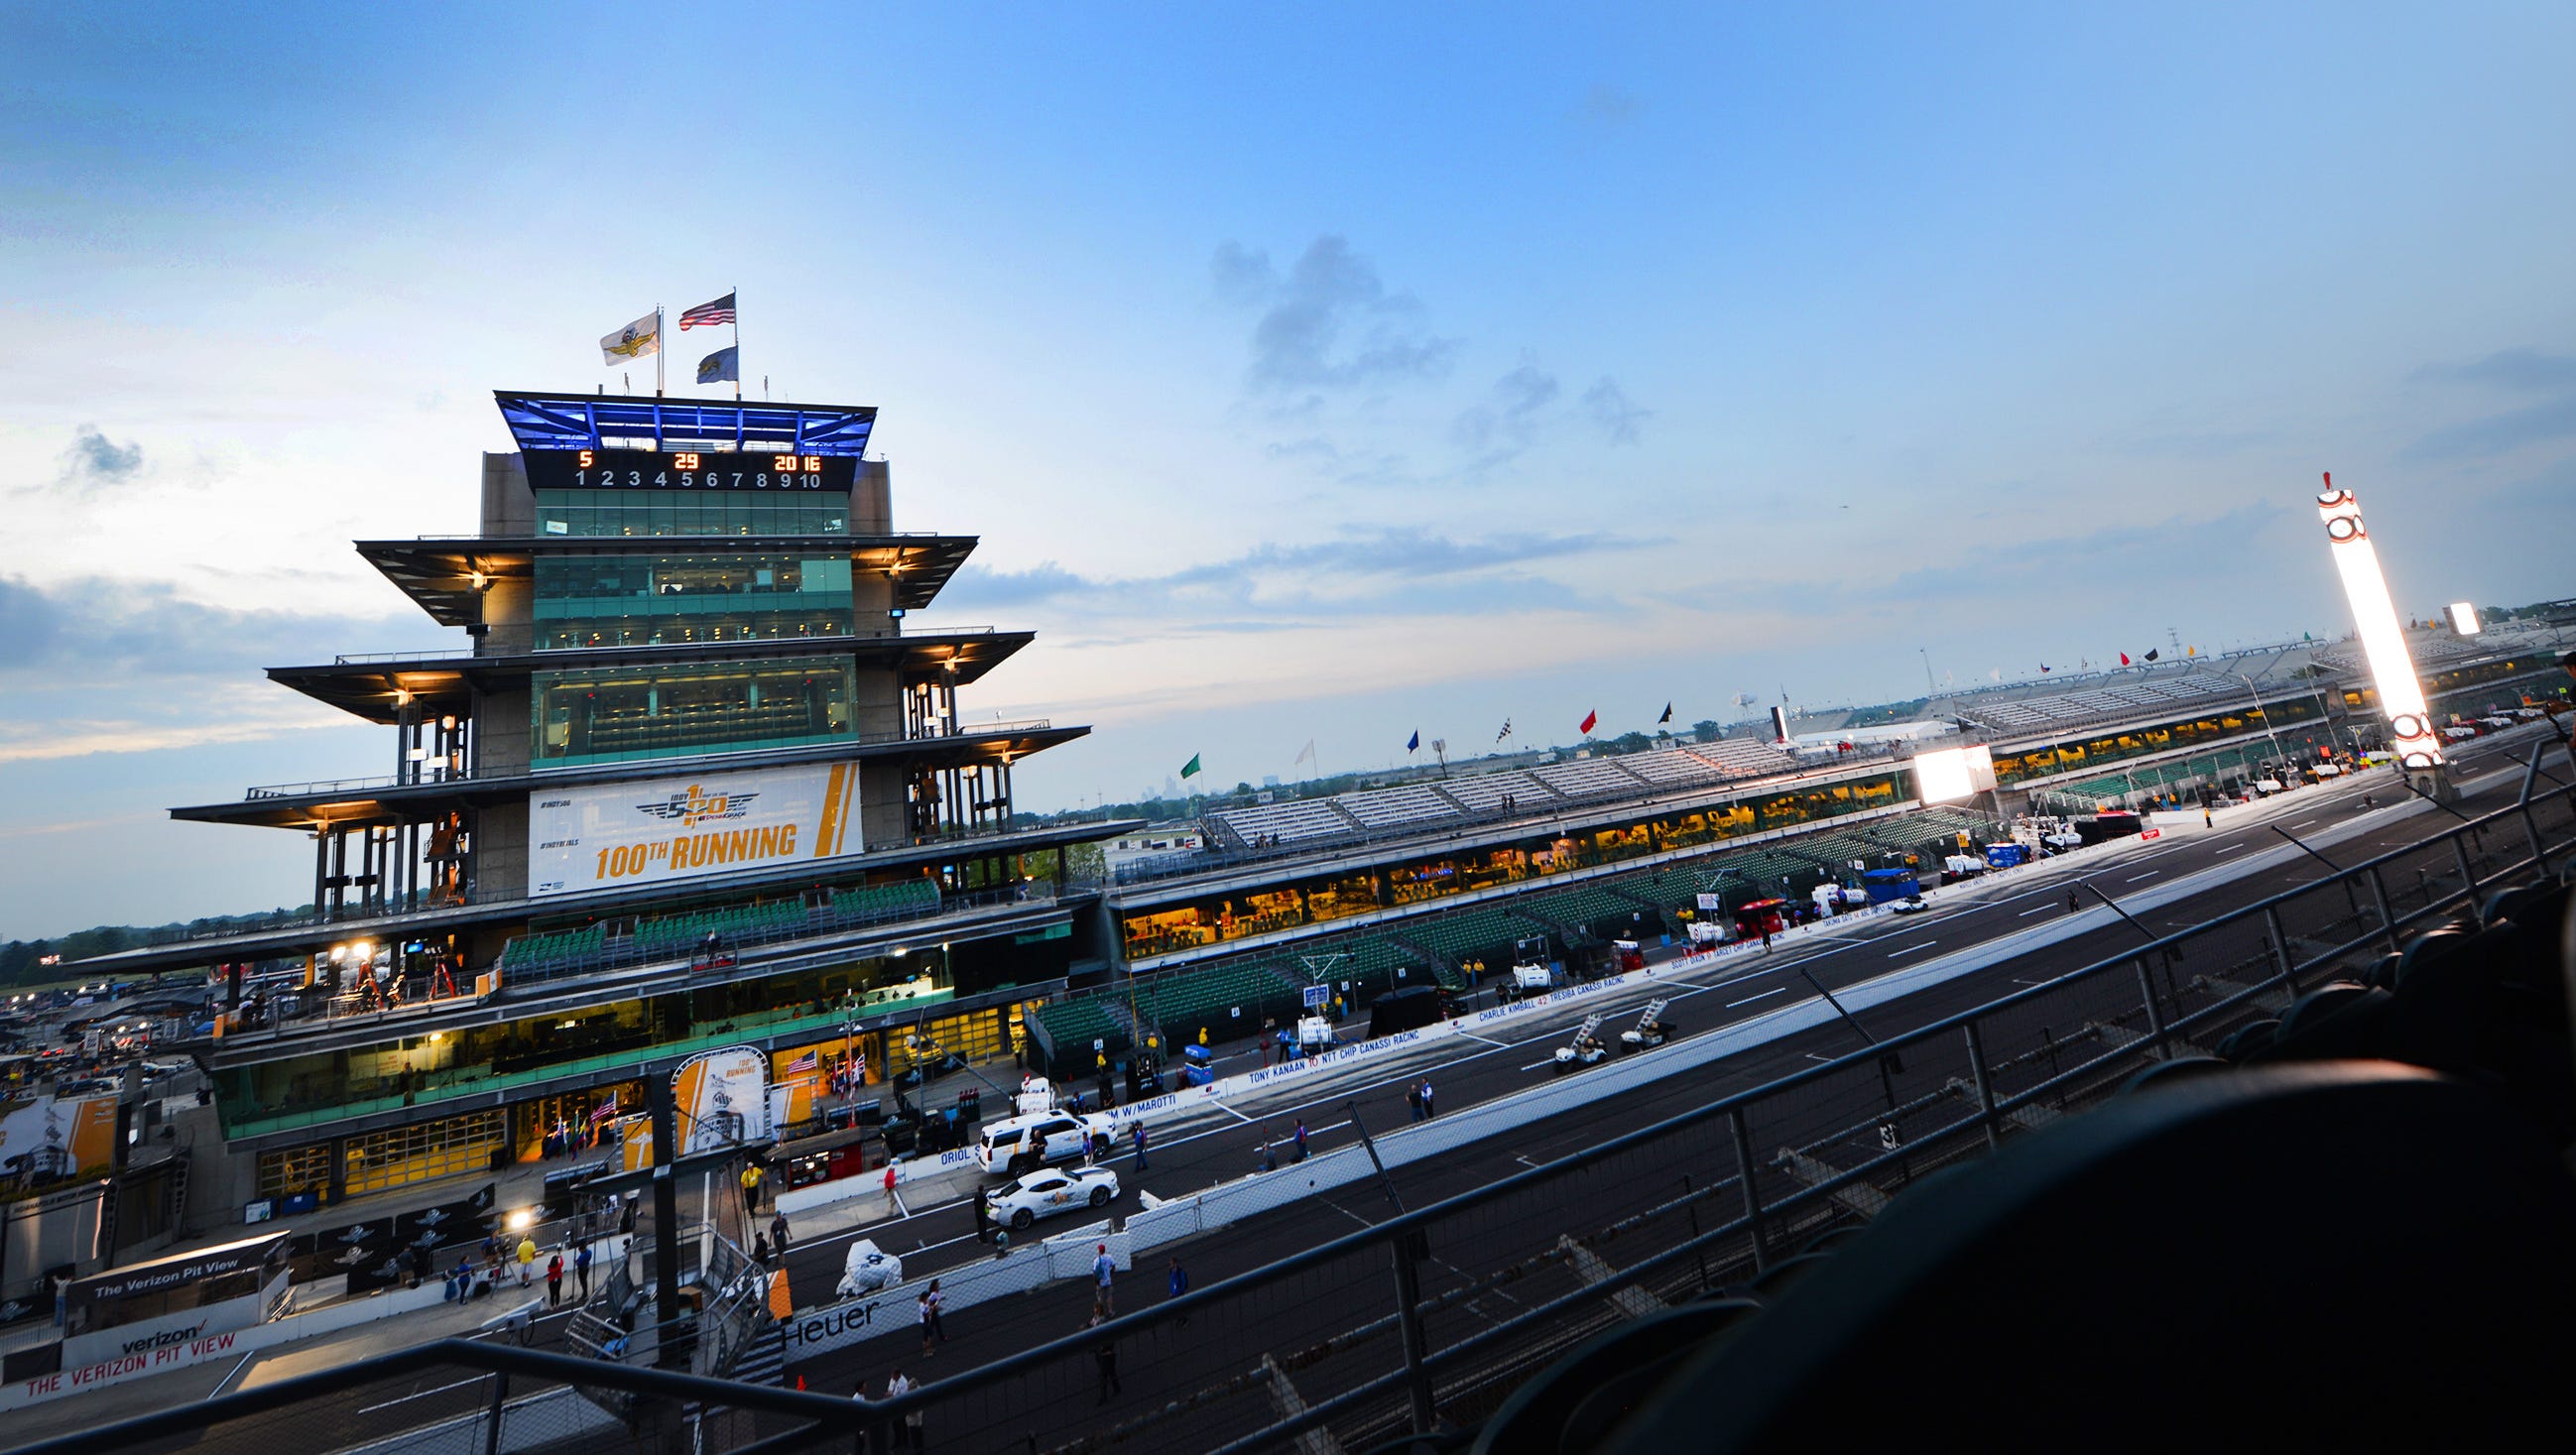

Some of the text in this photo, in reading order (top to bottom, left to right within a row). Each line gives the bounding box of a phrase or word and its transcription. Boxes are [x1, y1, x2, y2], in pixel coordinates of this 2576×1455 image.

[578, 450, 593, 468] 5
[674, 452, 699, 469] 29
[575, 469, 821, 489] 1 2 3 4 5 6 7 8 9 10
[596, 823, 797, 880] 100TH RUNNING
[1479, 1006, 1506, 1022] CHARLIE
[1508, 1000, 1535, 1015] KIMBALL
[1537, 996, 1547, 1005] 42
[1549, 989, 1575, 1002] TRESIBA
[1250, 1069, 1270, 1084] TONY
[1273, 1059, 1306, 1077] KANAAN
[1321, 1051, 1336, 1064] NTT
[1339, 1046, 1357, 1060] CHIP
[940, 1149, 971, 1165] ORIOL
[95, 1259, 239, 1298] The Verizon Pit View
[122, 1325, 198, 1355] verizon
[781, 1300, 881, 1352] Heuer
[26, 1332, 236, 1396] THE VERIZON PIT VIEW
